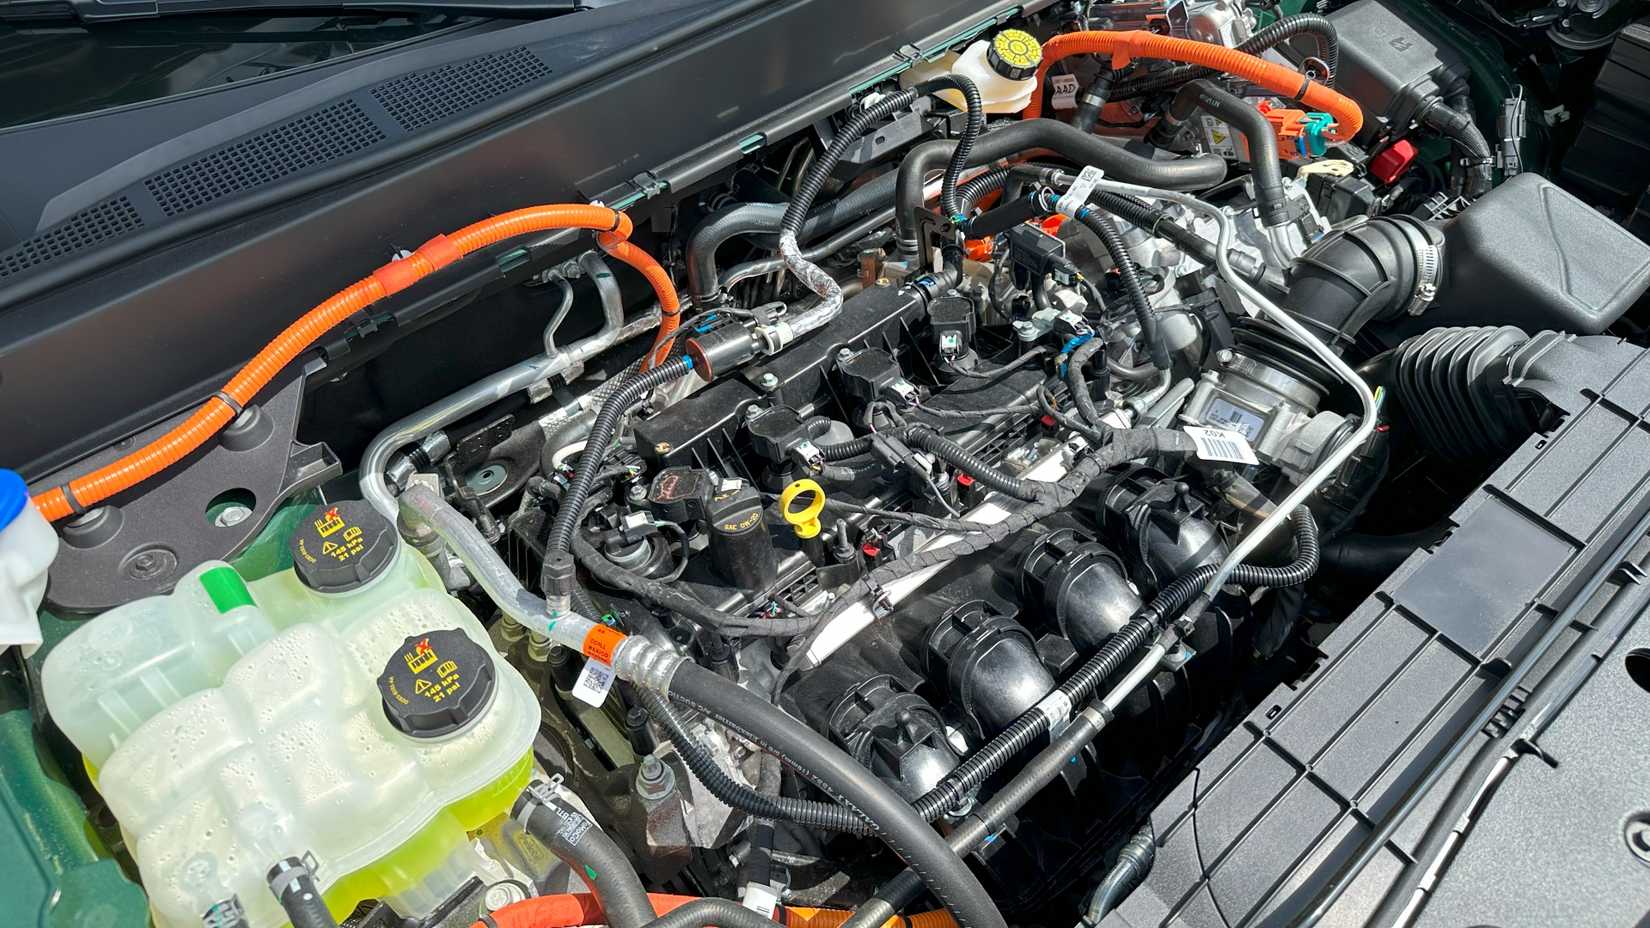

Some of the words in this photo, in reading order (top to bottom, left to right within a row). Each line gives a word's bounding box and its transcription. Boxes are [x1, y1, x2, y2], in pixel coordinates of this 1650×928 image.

[1055, 83, 1076, 95] AAD
[724, 523, 737, 531] SAE
[347, 536, 364, 549] kPa
[350, 543, 364, 556] psi
[441, 673, 460, 687] kPa
[433, 691, 445, 703] 21
[446, 682, 461, 695] psi
